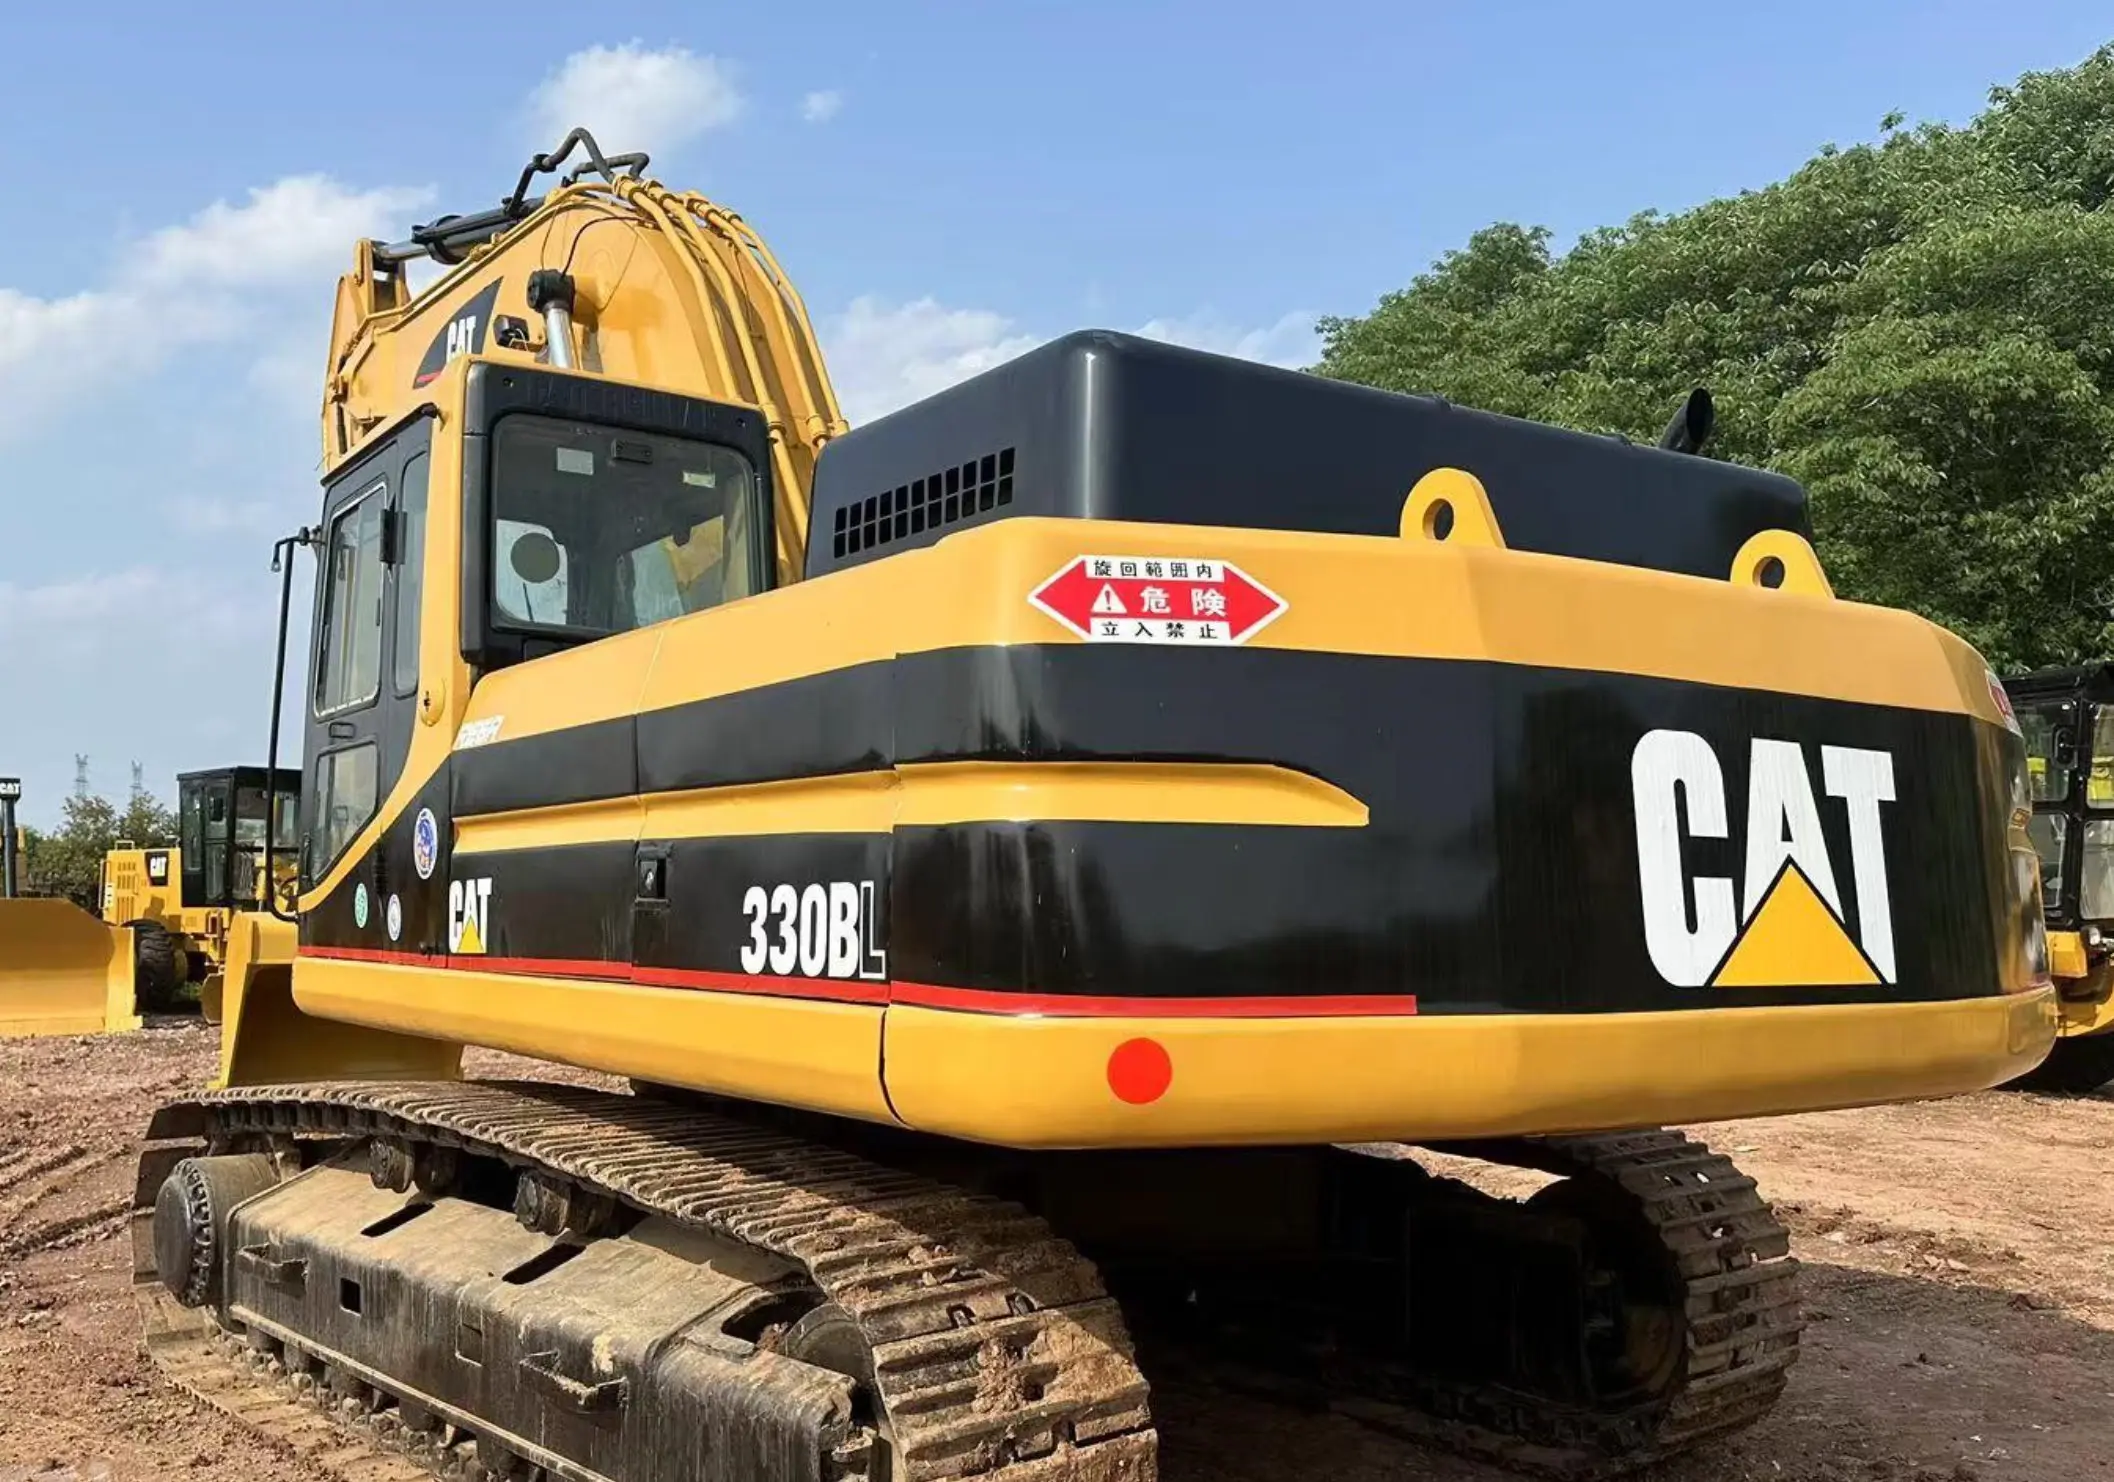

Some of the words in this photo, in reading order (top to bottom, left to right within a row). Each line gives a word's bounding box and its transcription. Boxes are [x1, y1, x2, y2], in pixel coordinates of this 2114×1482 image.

[1094, 560, 1213, 579] 旋回範囲内
[1139, 586, 1228, 617] 危険
[1102, 621, 1218, 640] 立入禁止
[1631, 729, 1897, 987] CAT
[449, 877, 493, 954] CAT
[740, 880, 886, 979] 330BL
